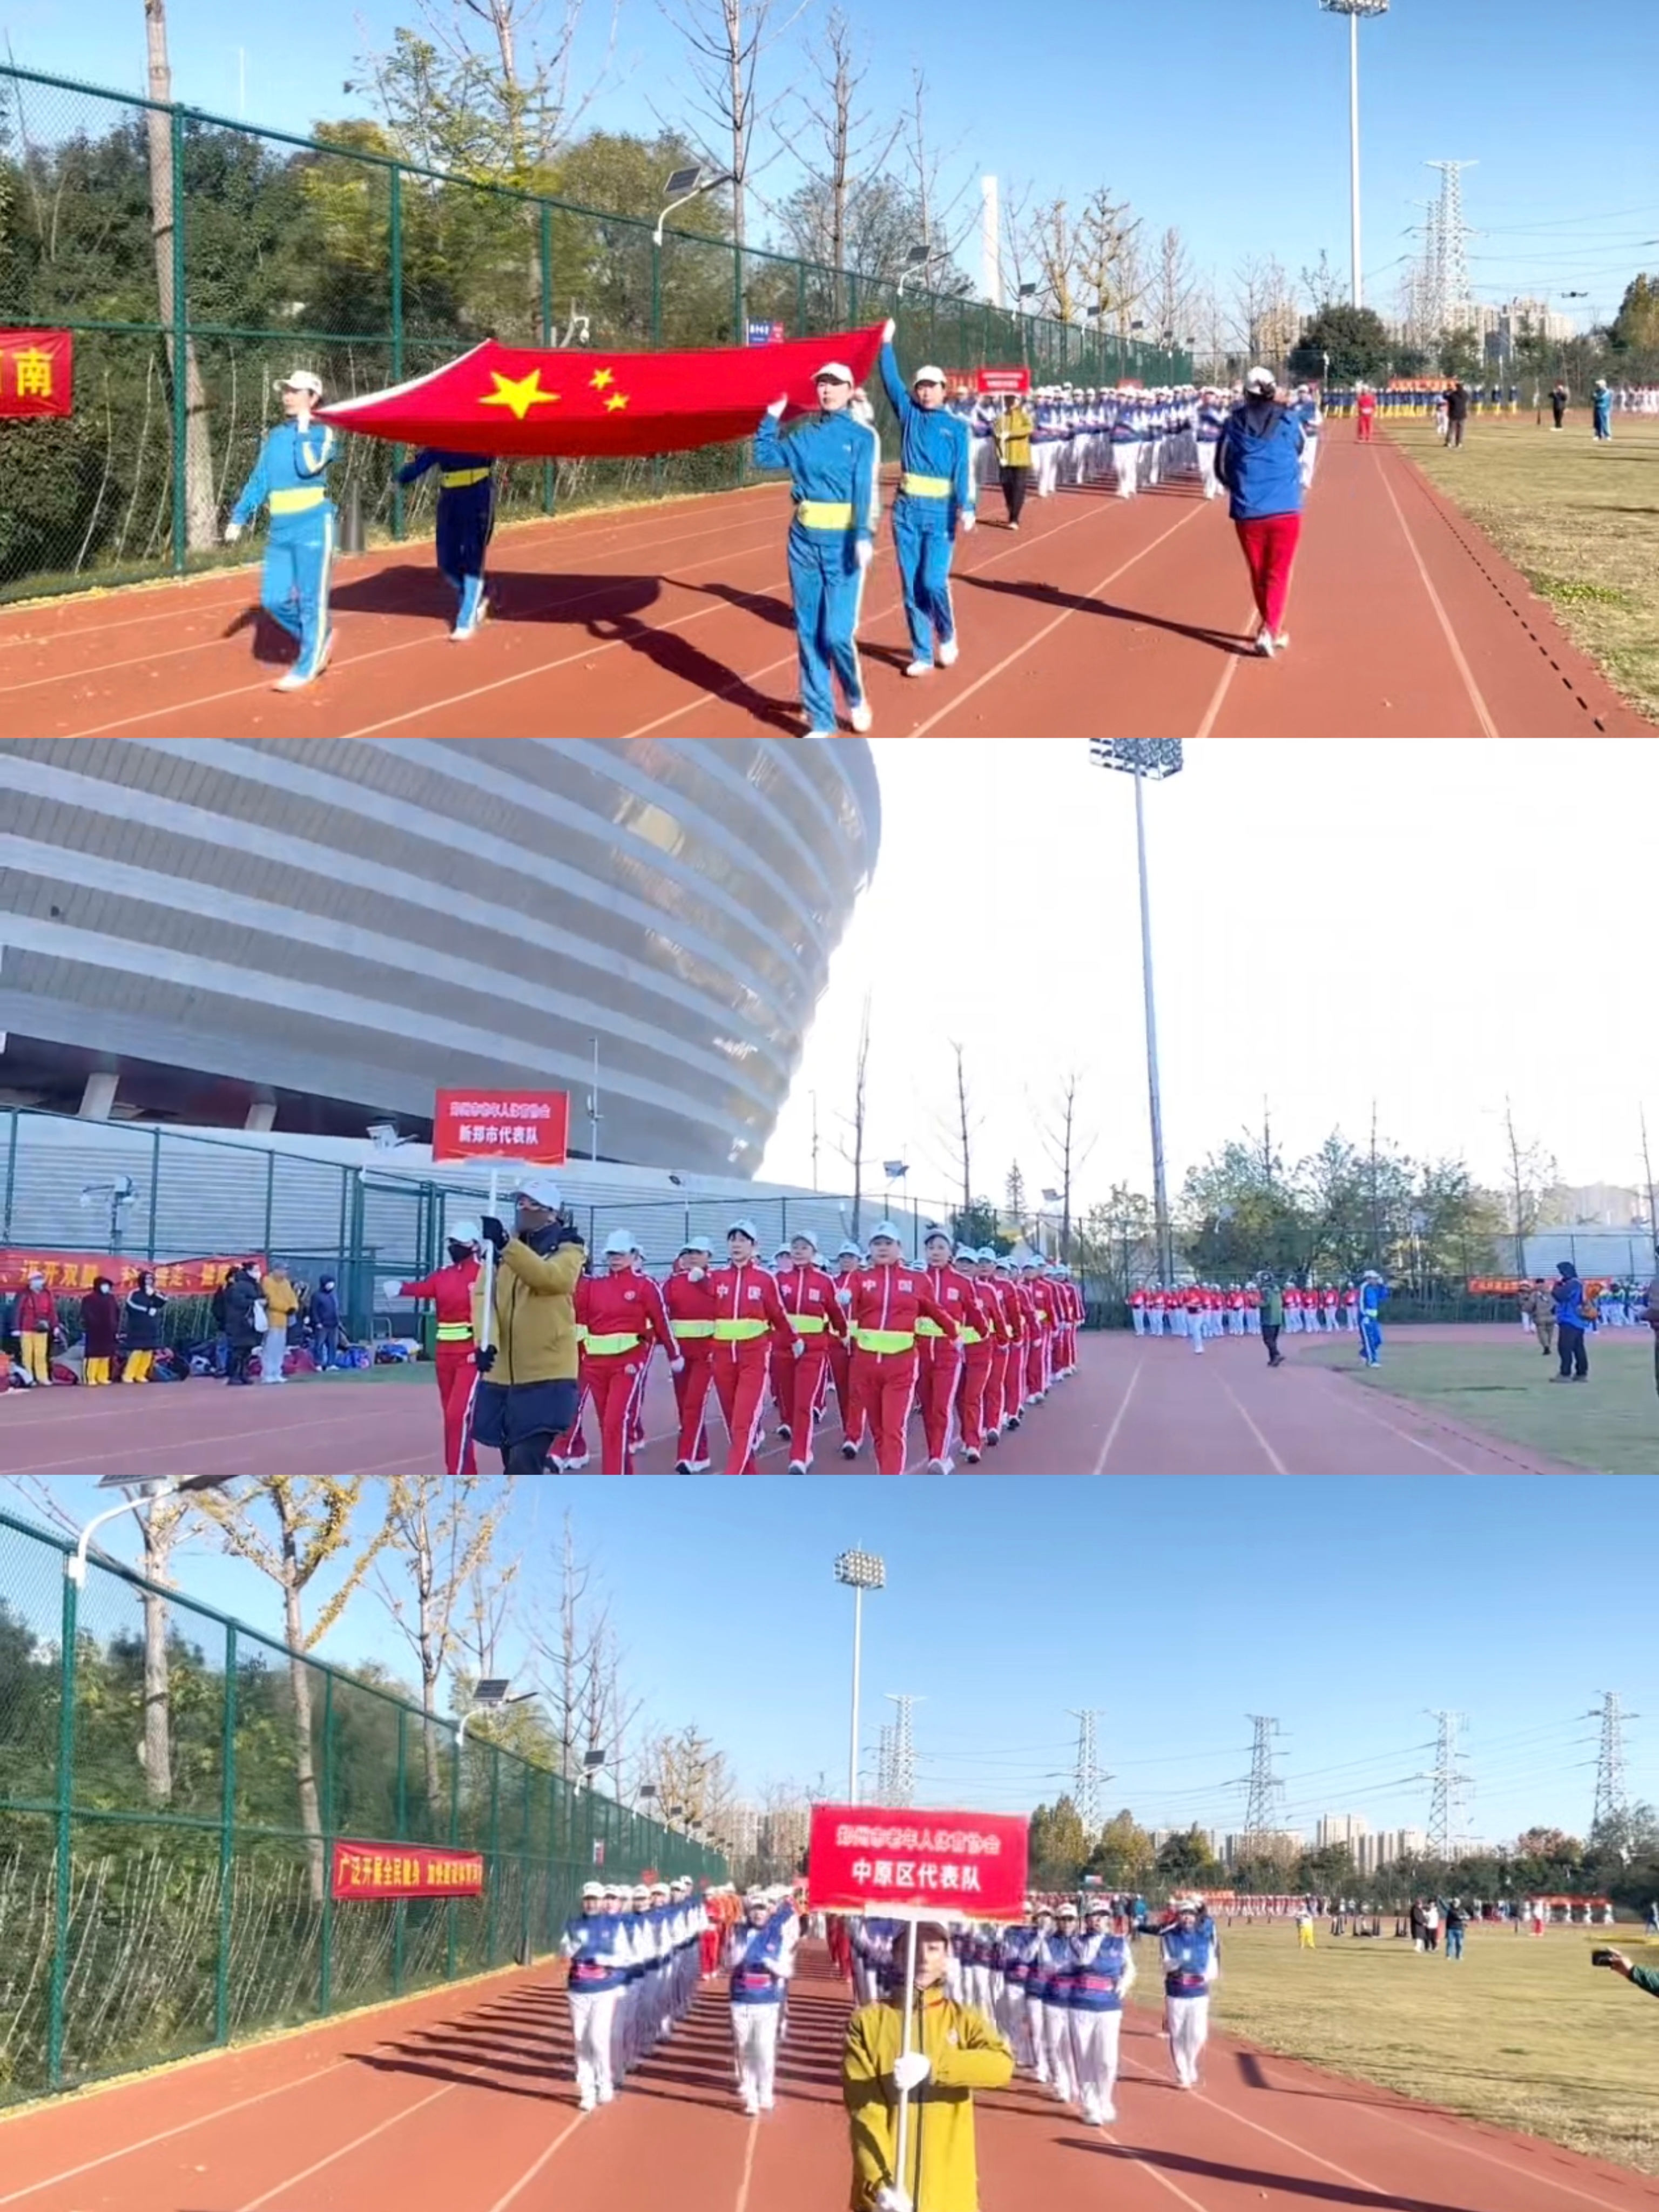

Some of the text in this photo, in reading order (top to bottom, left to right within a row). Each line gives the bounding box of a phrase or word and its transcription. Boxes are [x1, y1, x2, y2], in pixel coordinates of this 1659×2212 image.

[0, 347, 53, 398] 南
[459, 1125, 538, 1144] 新郑市代表队
[852, 1857, 981, 1892] 中原区代表队
